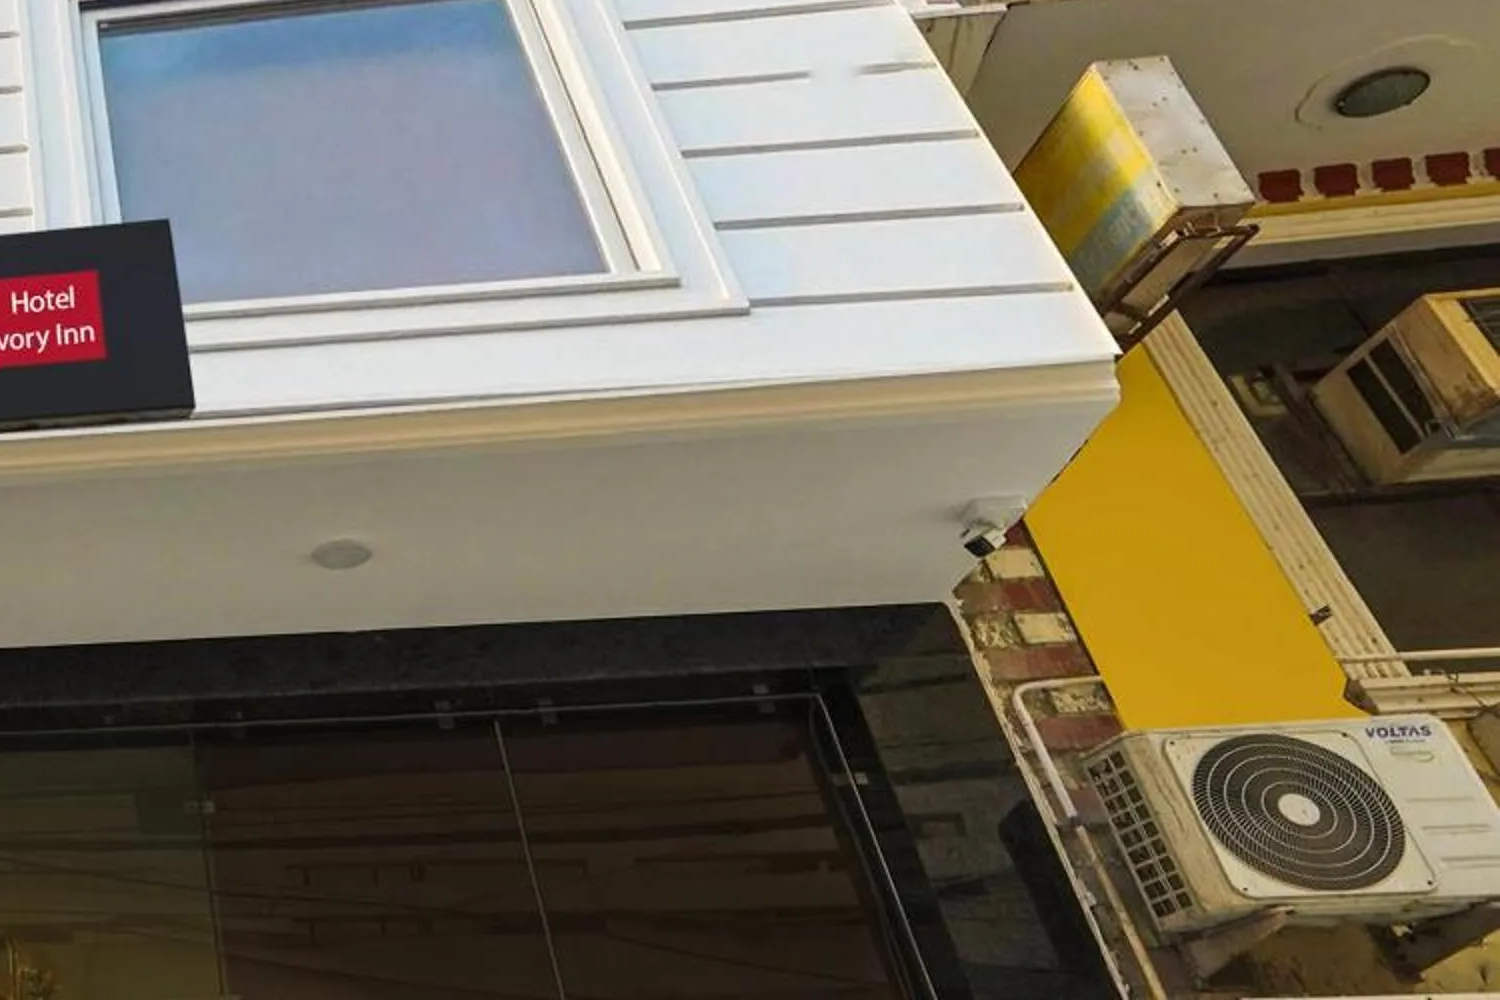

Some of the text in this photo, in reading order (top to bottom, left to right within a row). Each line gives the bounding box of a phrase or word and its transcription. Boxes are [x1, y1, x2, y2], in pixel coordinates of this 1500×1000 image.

[11, 284, 75, 314] Hotel
[56, 323, 96, 346] Inn
[1365, 725, 1432, 738] VOLTAS
